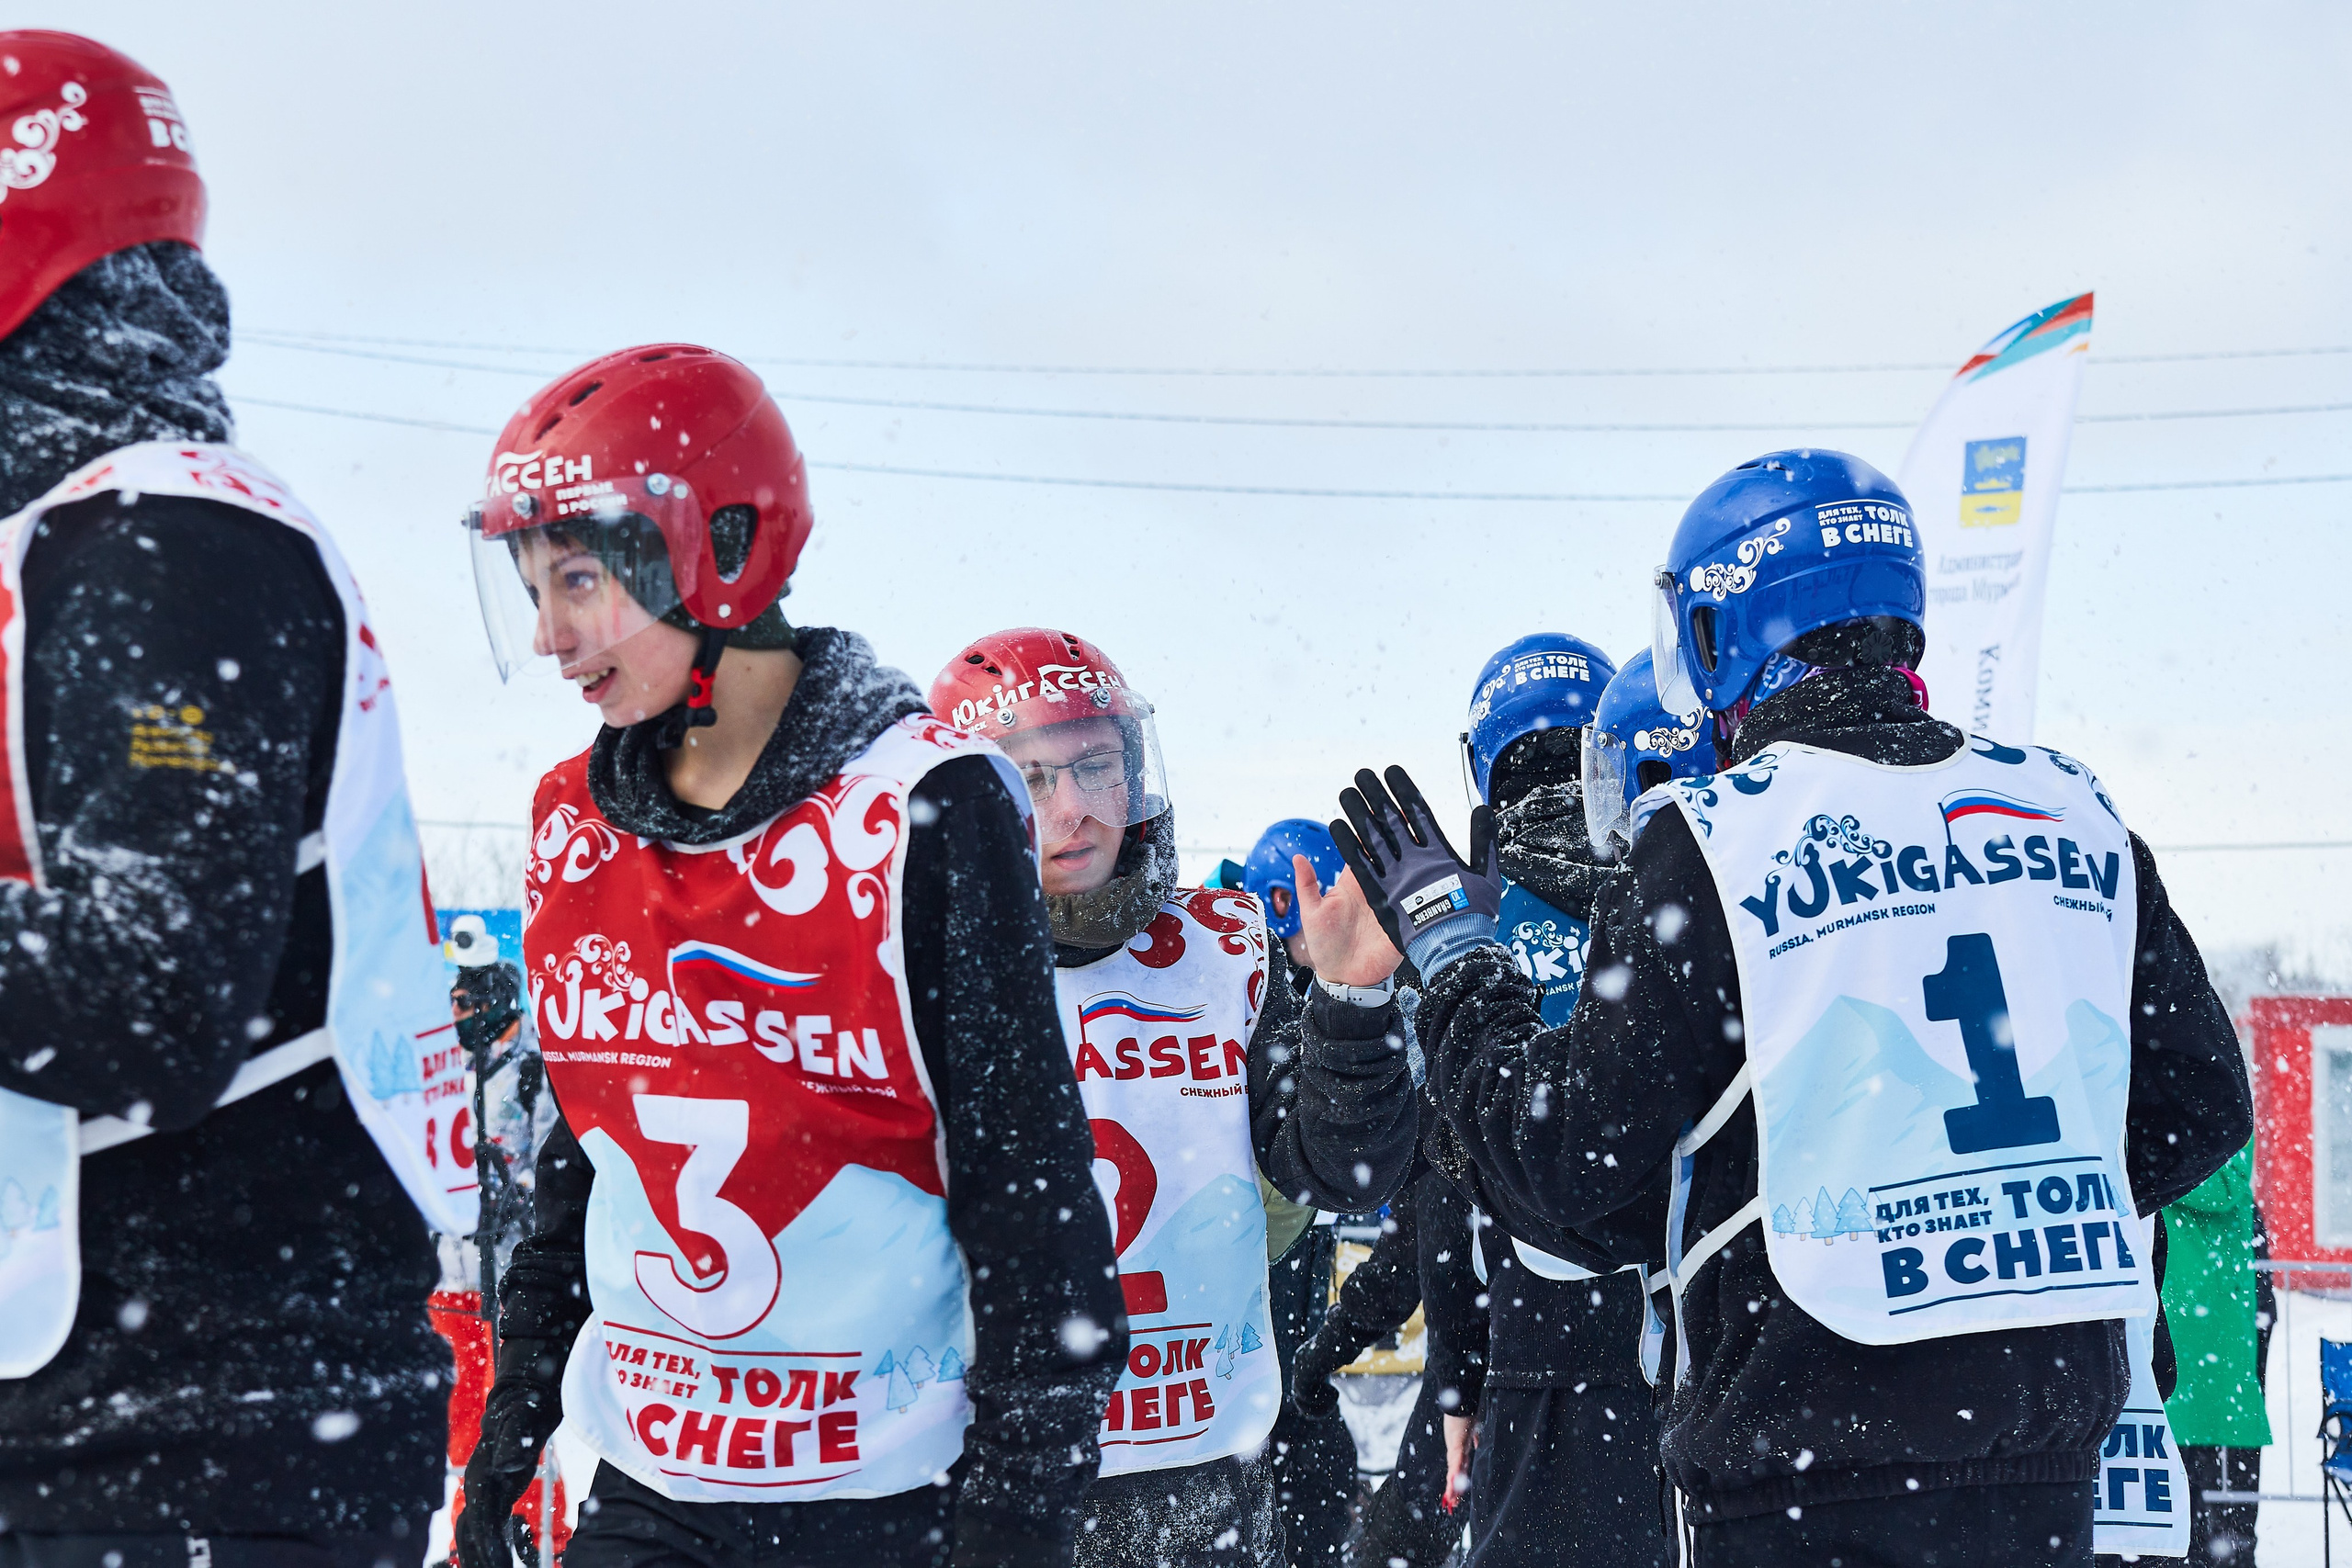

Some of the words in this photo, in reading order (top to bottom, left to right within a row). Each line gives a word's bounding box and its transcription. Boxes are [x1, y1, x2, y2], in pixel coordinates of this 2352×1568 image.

[555, 481, 613, 501] ПЕРВЫЕ
[558, 503, 569, 514] В
[1818, 508, 1839, 520] ДЛЯ
[1839, 506, 1862, 515] ТЕХ,
[1864, 505, 1909, 528] ТОЛК
[1819, 517, 1838, 526] КТО
[1838, 514, 1863, 524] ЗНАЕТ
[1821, 526, 1841, 548] В
[1845, 523, 1914, 548] СНЕГЕ
[1515, 671, 1528, 685] В
[1530, 665, 1590, 682] СНЕГЕ
[1546, 655, 1589, 670] ТОЛК
[1451, 891, 1462, 902] 10
[1415, 898, 1452, 924] GRANBERG
[1769, 933, 1815, 960] RUSSIA,
[1815, 908, 1890, 939] MURMANSK
[1892, 903, 1936, 918] REGION
[1922, 932, 2061, 1155] 1
[568, 1051, 618, 1064] MURMANSK
[620, 1052, 672, 1068] REGION
[1180, 1083, 1243, 1098] СНЕЖНЫЙ
[632, 1094, 781, 1339] 3
[1876, 1195, 1930, 1224] ДЛЯ
[1933, 1187, 1989, 1211] ТЕХ,
[1878, 1223, 1921, 1244] КТО
[1925, 1210, 1993, 1234] ЗНАЕТ
[1881, 1247, 1929, 1298] В
[652, 1351, 701, 1380] ТЕХ,
[710, 1363, 862, 1411] ТОЛК
[637, 1403, 860, 1469] СНЕГЕ
